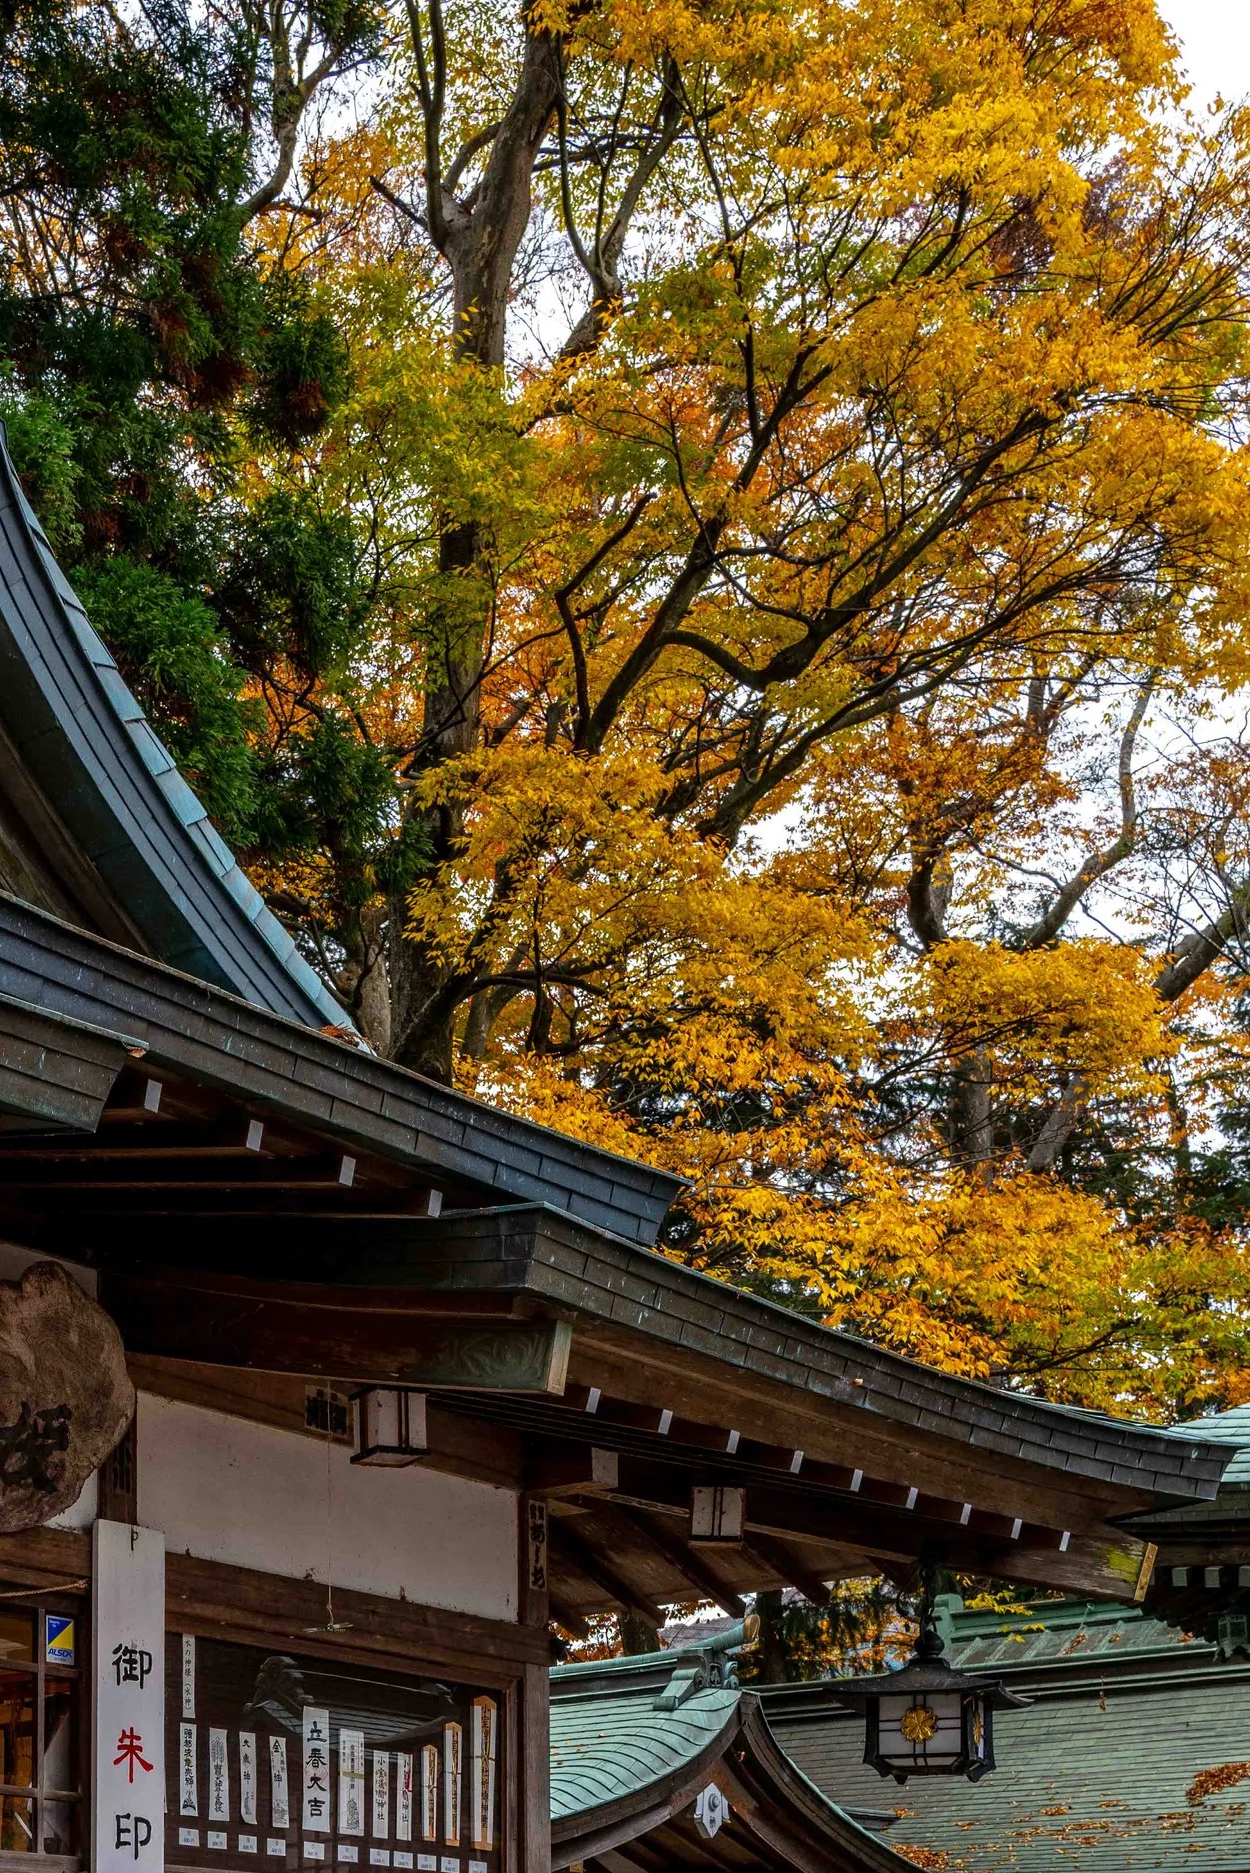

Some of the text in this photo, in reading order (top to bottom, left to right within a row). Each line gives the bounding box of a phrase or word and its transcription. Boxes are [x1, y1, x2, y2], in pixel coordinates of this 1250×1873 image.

[48, 1648, 73, 1658] ALSOK
[306, 1720, 327, 1818] 立春大吉
